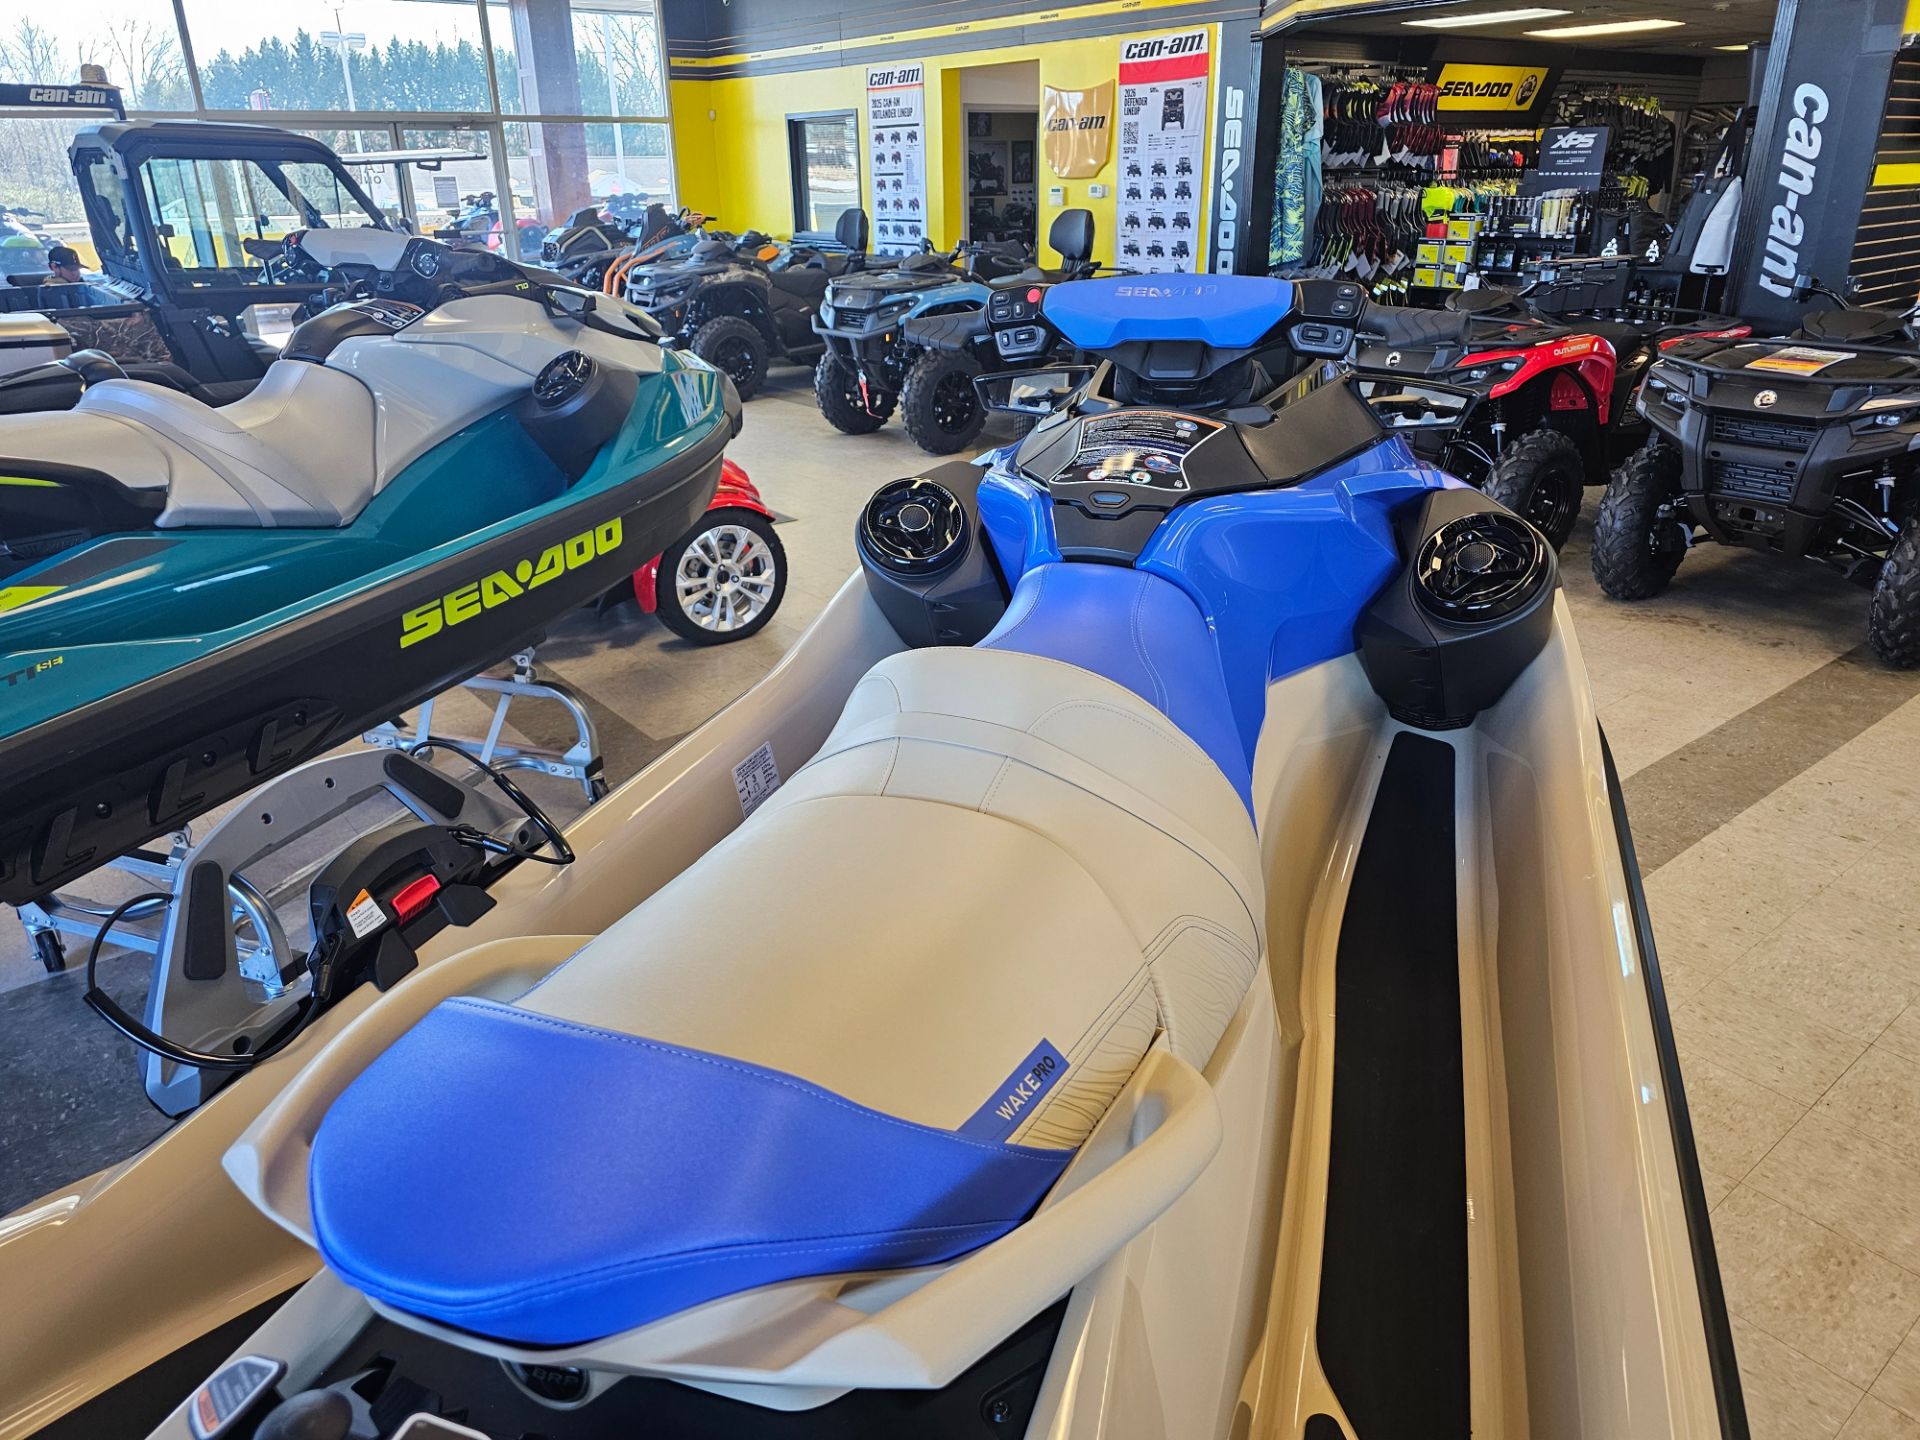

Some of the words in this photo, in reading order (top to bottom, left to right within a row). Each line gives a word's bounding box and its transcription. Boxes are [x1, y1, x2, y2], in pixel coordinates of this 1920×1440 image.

[1125, 33, 1203, 59] can-am
[870, 68, 920, 86] can-am
[30, 88, 106, 104] can-am
[1550, 131, 1598, 149] XPS
